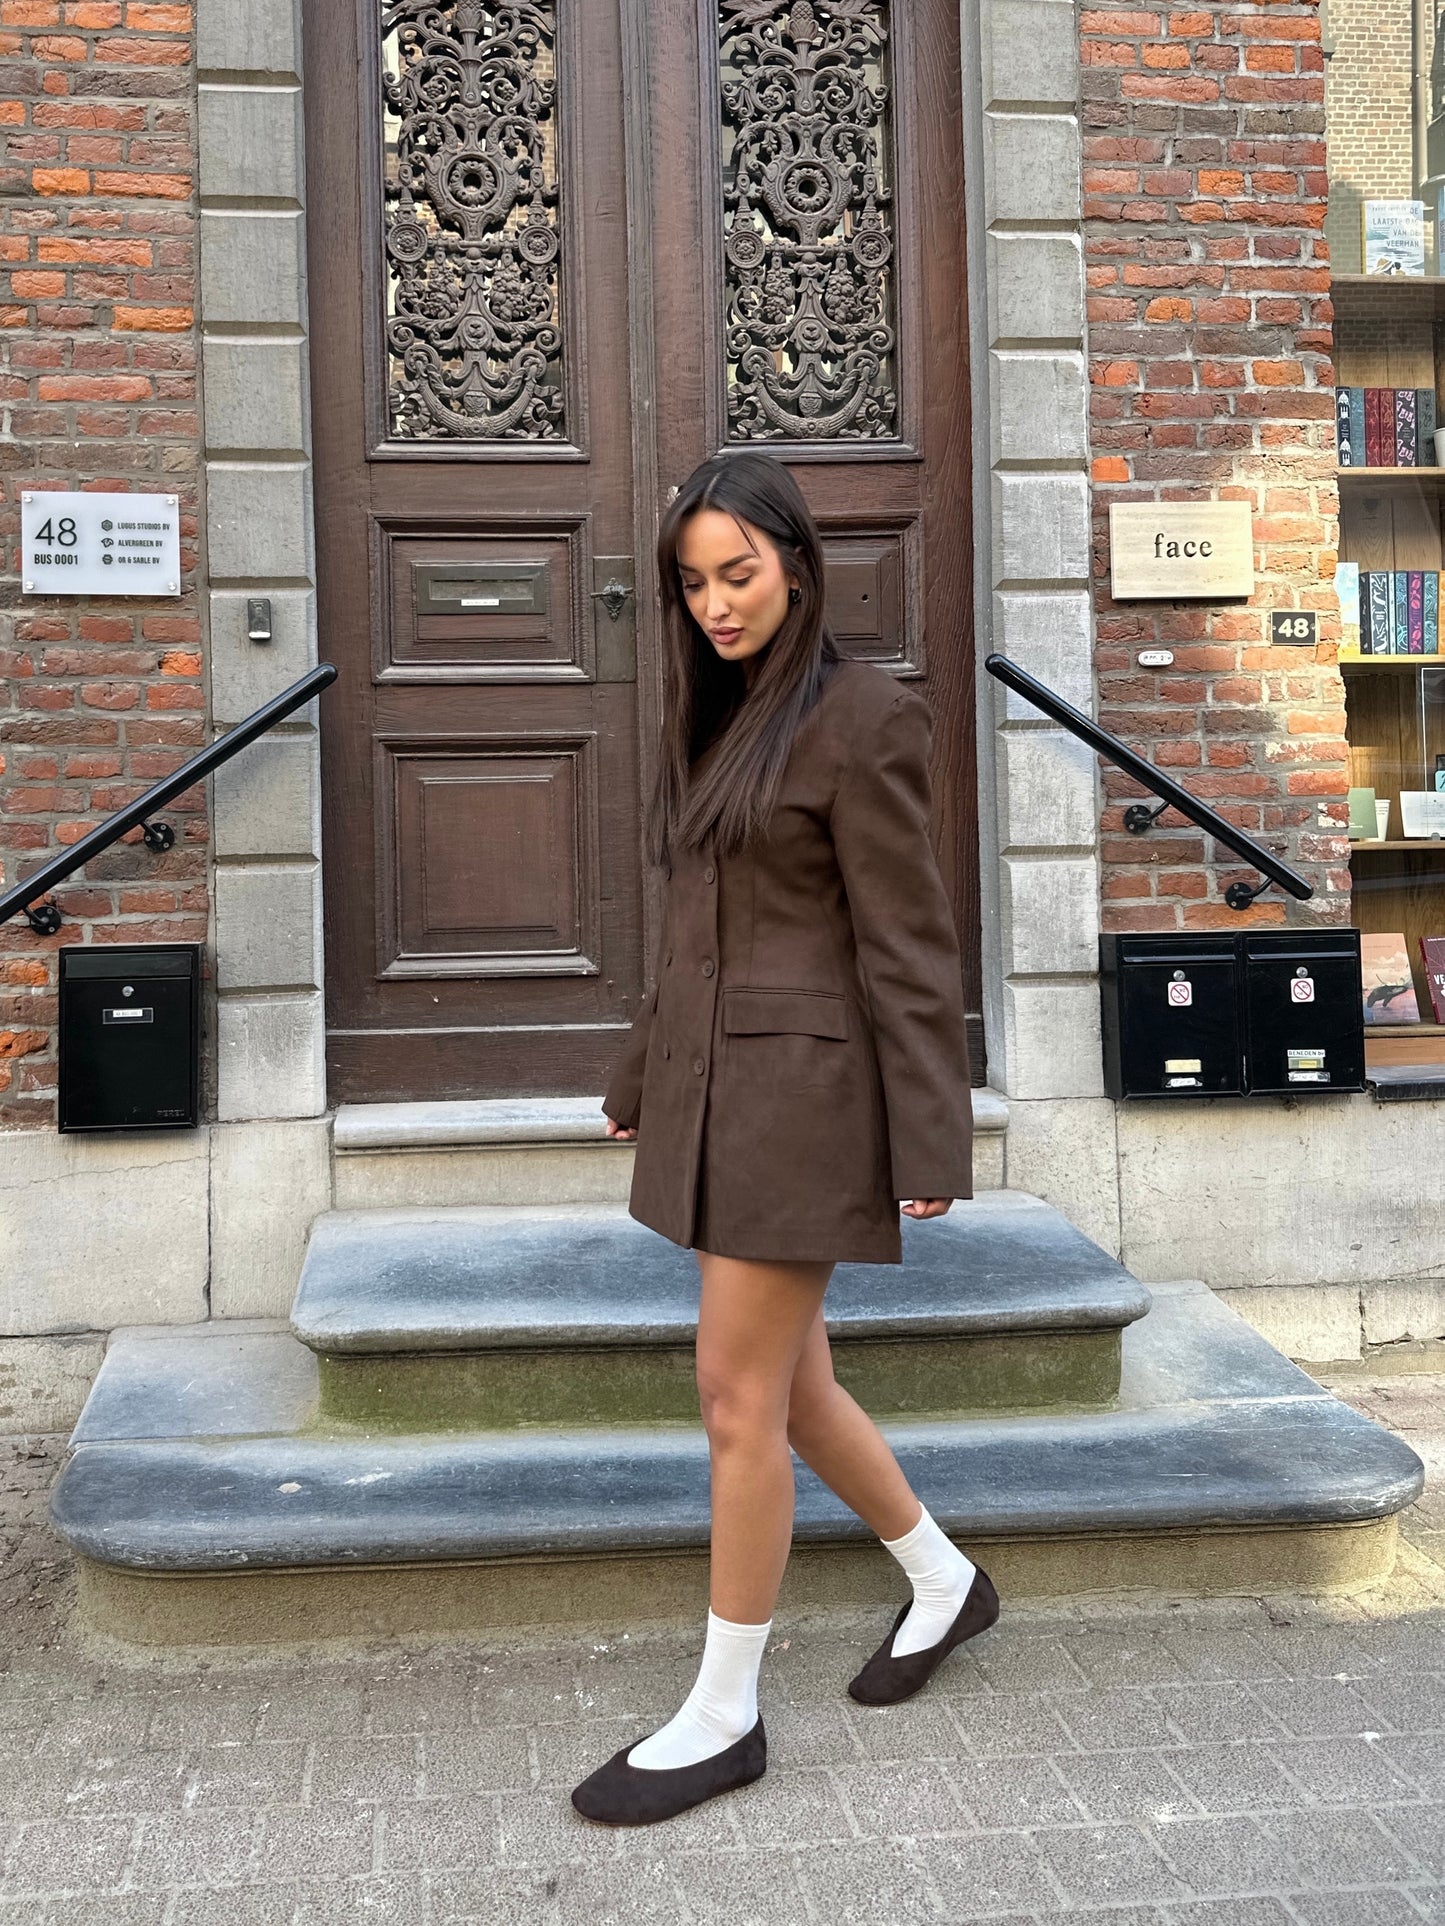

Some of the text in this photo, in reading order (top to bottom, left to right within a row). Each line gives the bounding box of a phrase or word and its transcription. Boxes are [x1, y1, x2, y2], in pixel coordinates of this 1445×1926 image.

[35, 517, 77, 546] 48
[137, 522, 161, 530] STUDIOS
[118, 539, 154, 547] ALVERGREEN
[1154, 532, 1213, 558] face
[34, 554, 78, 565] BUS 0001
[132, 556, 151, 564] SABLE
[1278, 617, 1309, 638] 48
